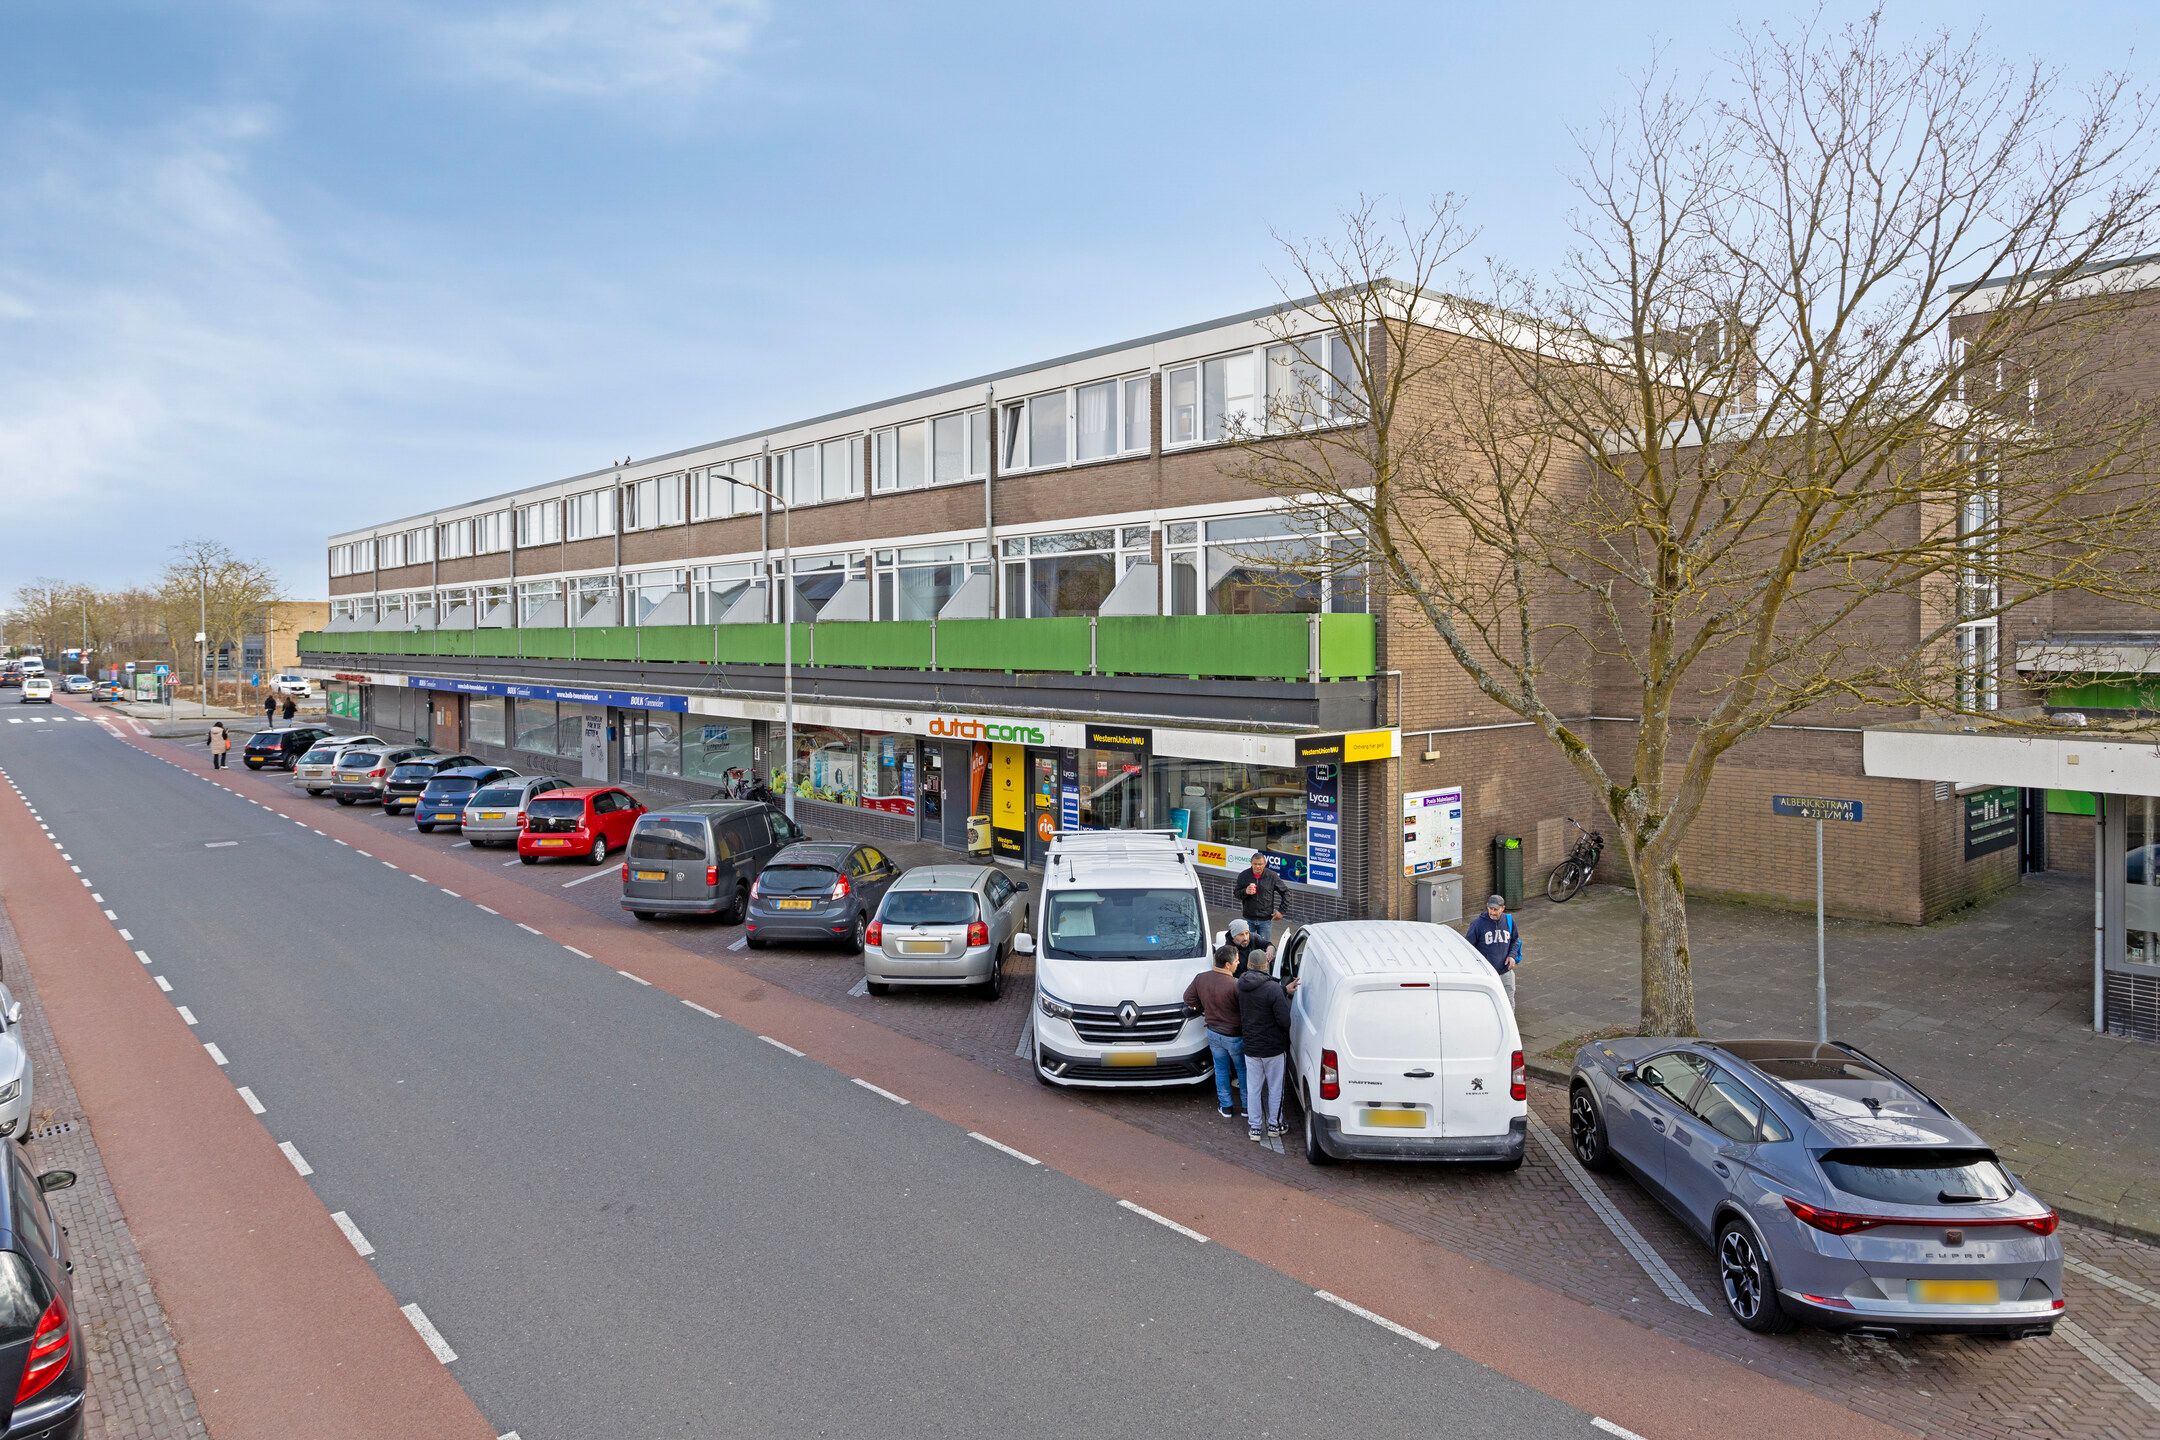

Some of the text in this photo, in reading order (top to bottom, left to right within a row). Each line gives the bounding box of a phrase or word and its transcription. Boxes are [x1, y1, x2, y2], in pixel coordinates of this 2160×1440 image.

[630, 696, 644, 706] BOLK
[929, 717, 1045, 744] dutchcoms
[1309, 792, 1329, 804] Lyca
[1780, 797, 1854, 811] ALBERICKSTRAAT
[1812, 809, 1854, 821] 23 T/M 49
[1201, 850, 1222, 860] DHL
[1264, 855, 1280, 865] yca
[1484, 929, 1511, 945] GAP
